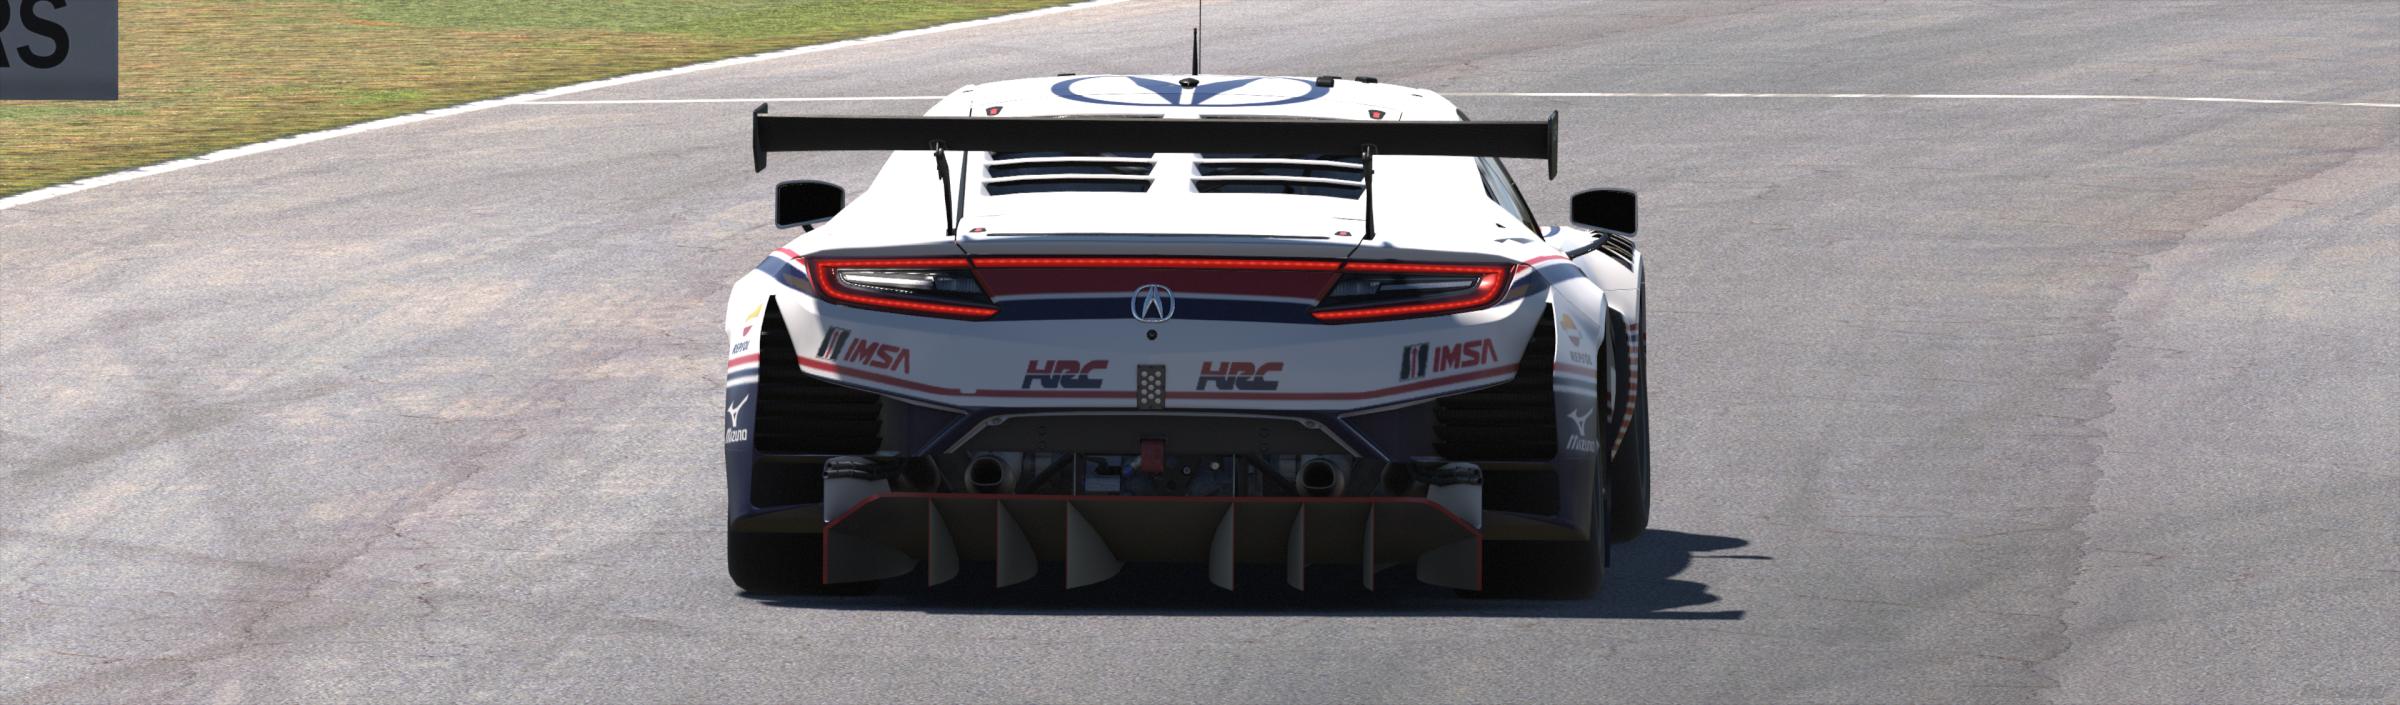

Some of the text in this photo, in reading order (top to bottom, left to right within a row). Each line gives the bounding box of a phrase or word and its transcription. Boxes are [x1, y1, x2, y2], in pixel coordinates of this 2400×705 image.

[844, 337, 911, 374] IMSA
[1433, 338, 1498, 373] IMSA
[1021, 360, 1109, 389] HRC
[1196, 361, 1284, 391] HRC
